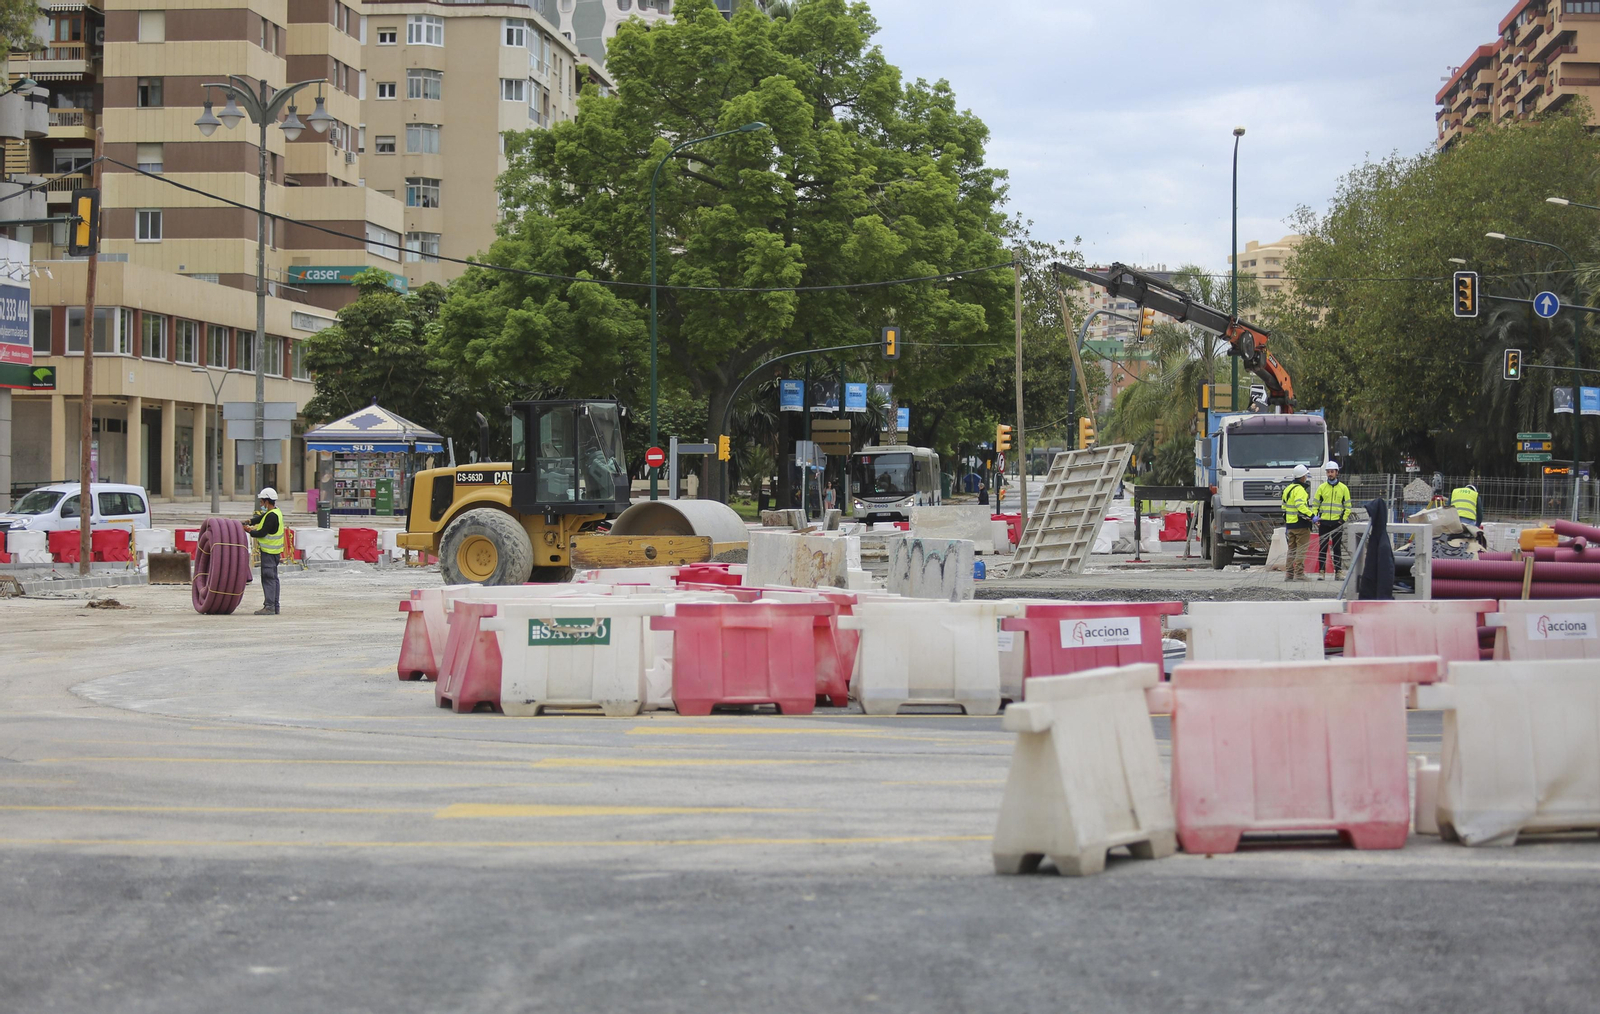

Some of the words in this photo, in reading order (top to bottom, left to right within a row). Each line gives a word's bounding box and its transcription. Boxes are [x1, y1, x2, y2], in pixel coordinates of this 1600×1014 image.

[306, 270, 340, 280] caser
[7, 299, 16, 321] 333
[18, 300, 28, 322] 444
[1524, 442, 1530, 450] P
[457, 473, 483, 482] CS-563D
[494, 472, 512, 485] CAT
[1548, 620, 1587, 631] acciona
[1085, 626, 1129, 638] acciona
